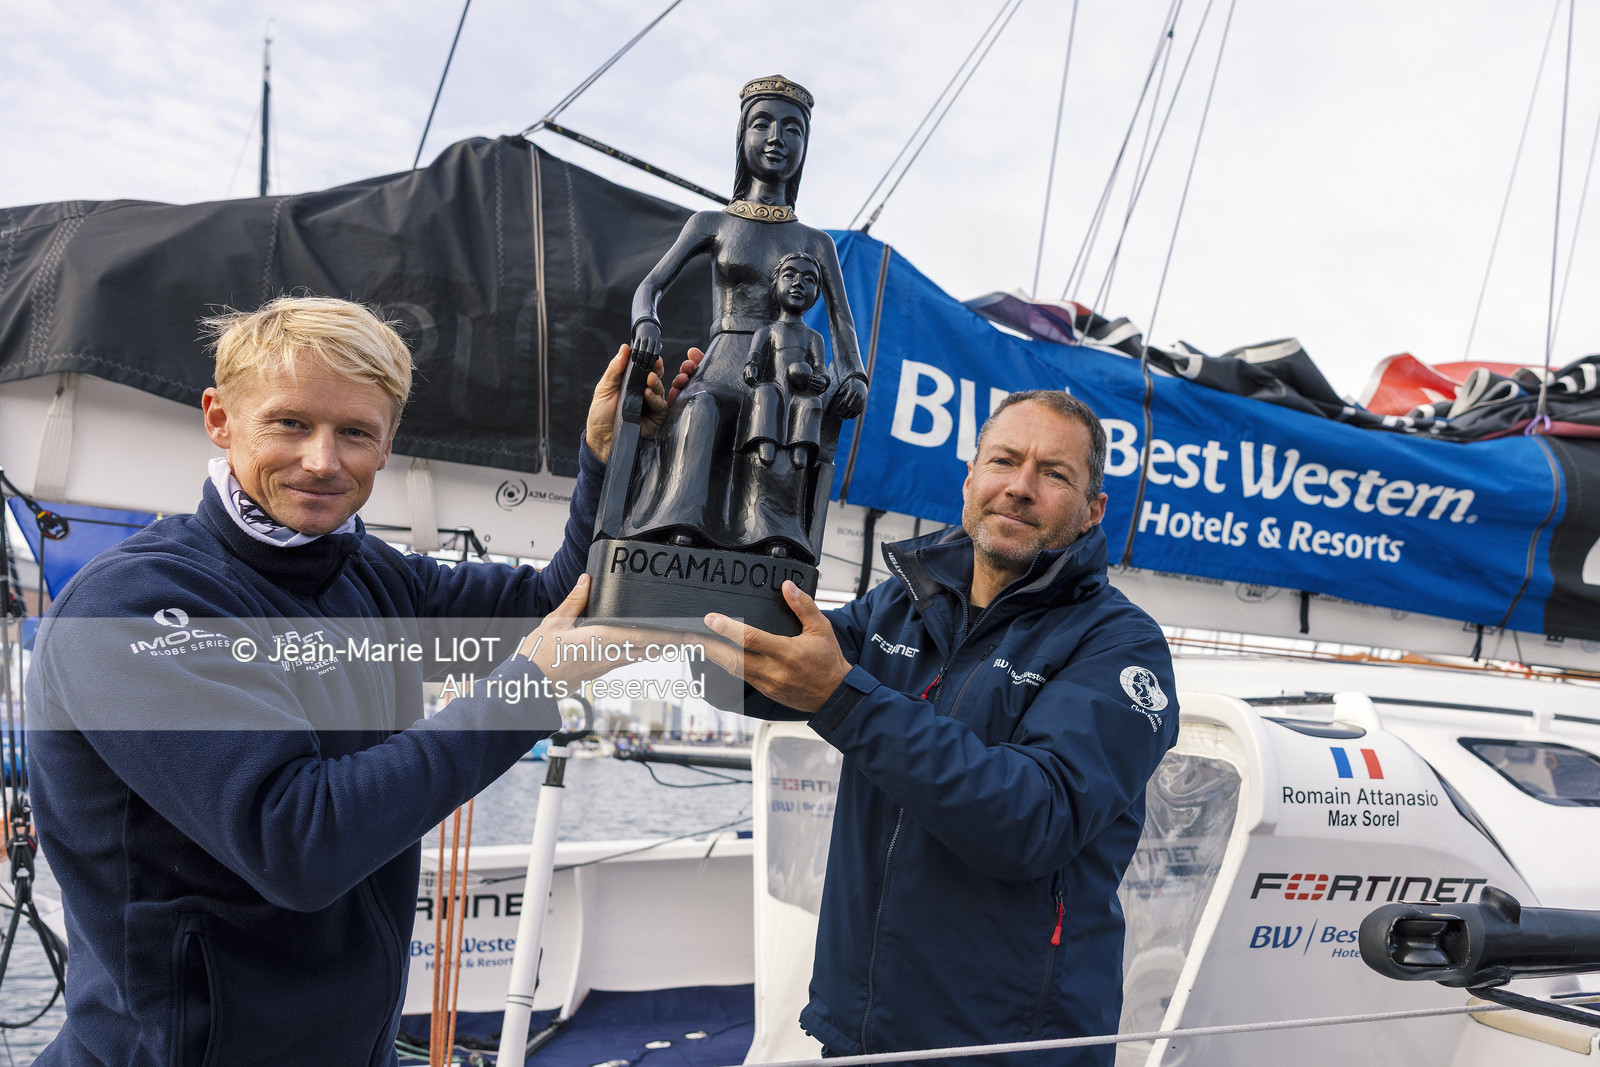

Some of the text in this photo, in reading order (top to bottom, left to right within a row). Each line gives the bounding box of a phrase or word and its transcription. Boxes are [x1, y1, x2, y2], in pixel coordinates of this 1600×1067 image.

[1102, 418, 1229, 494] Best
[1138, 501, 1405, 563] Hotels & Resorts
[190, 639, 231, 652] SERIES
[1282, 786, 1439, 807] Romain Attanasio
[1328, 810, 1400, 827] Max Sorel
[1250, 872, 1488, 903] FORTINET
[1249, 925, 1359, 949] BW Bes
[1331, 948, 1361, 958] Hote
